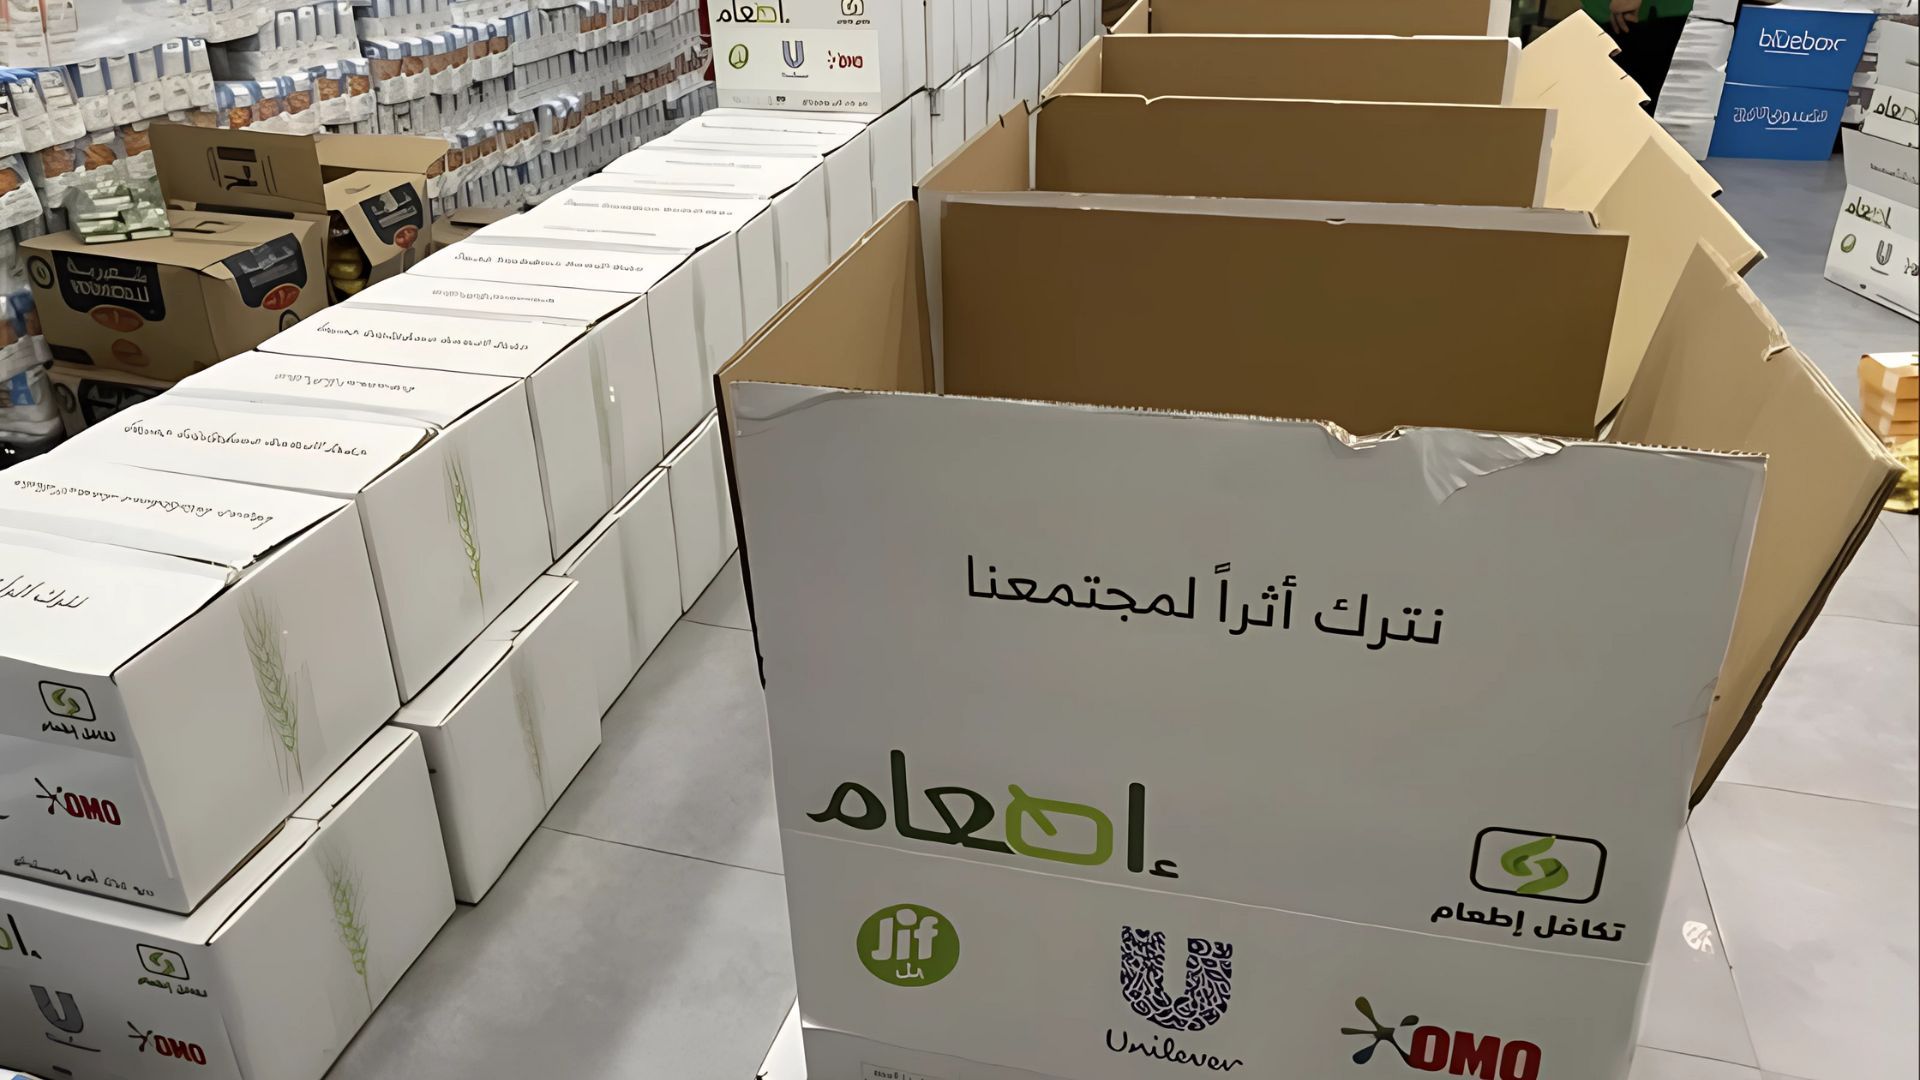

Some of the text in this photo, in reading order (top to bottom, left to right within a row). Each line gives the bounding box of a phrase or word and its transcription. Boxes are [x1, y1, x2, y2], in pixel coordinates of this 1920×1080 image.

[967, 554, 1444, 651] نترك أثراً لمجتمعنا
[64, 792, 121, 826] OMO
[871, 908, 939, 961] Jif
[1430, 902, 1627, 943] تكافل إطعام
[1106, 1028, 1243, 1072] Unilever
[1408, 1025, 1542, 1080] OMO
